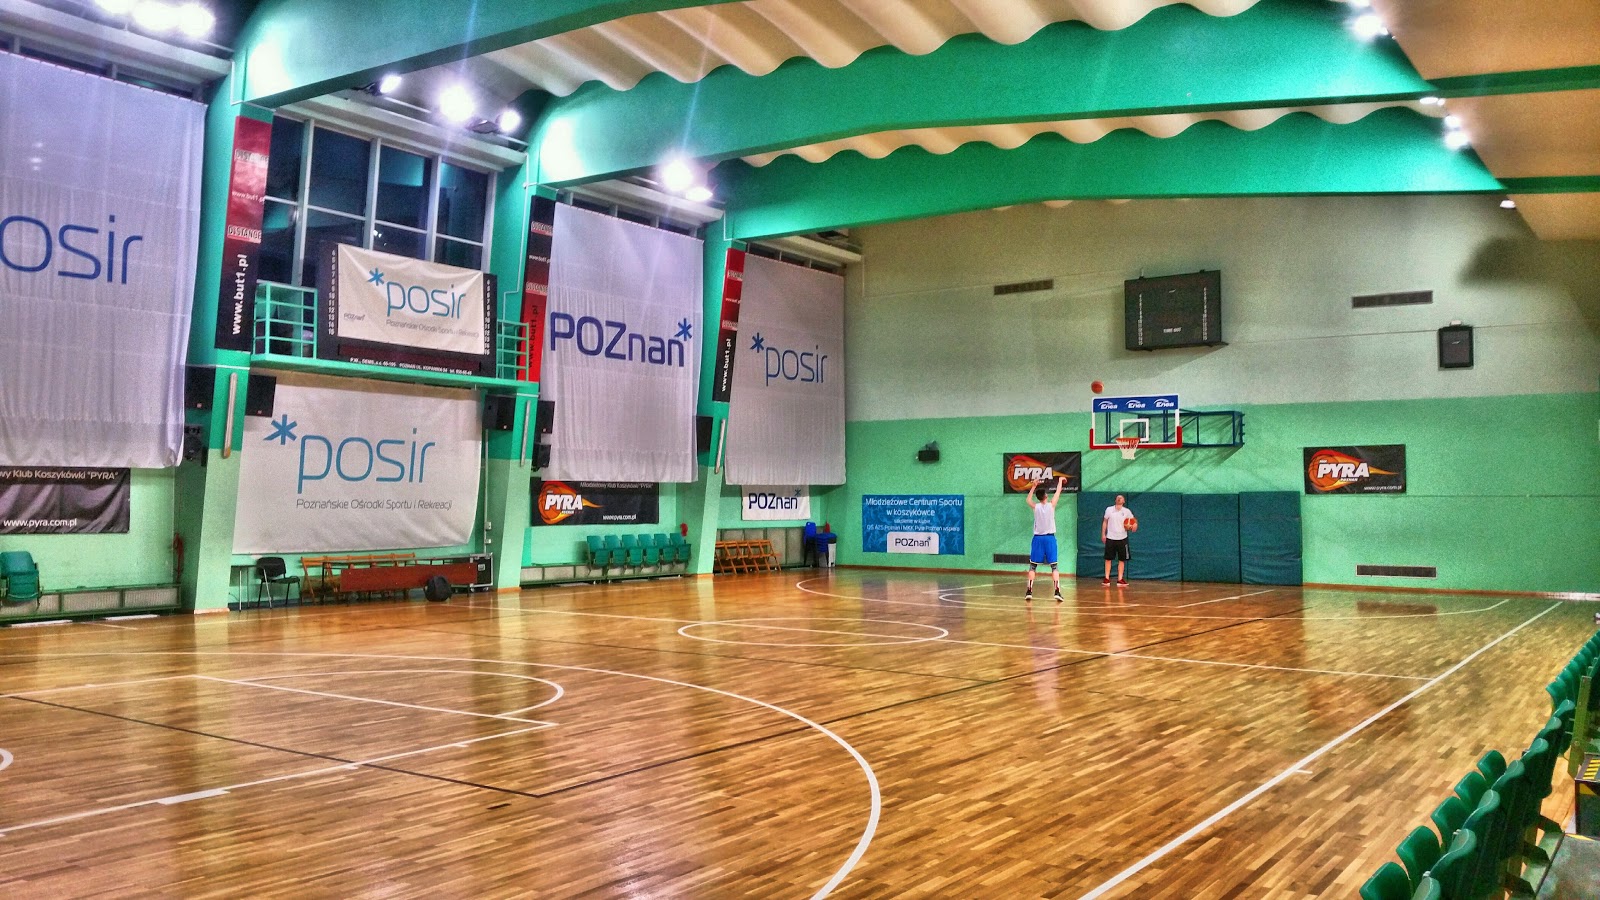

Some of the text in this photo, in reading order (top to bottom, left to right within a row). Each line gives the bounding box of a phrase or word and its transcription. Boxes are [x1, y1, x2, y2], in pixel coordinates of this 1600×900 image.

[228, 225, 262, 241] DISTANCE
[231, 253, 248, 335] www.but1.pl
[386, 281, 466, 319] posir
[721, 338, 732, 392] www.but1.pl
[766, 345, 828, 387] posir
[297, 428, 436, 495] posir
[12, 469, 33, 478] Klub
[34, 470, 86, 480] Koszykówki
[1014, 466, 1054, 480] PYRA
[1317, 462, 1370, 478] PYRA
[296, 498, 349, 510] Poznańskie
[350, 499, 384, 510] Ośrodki
[386, 500, 412, 511] Sportu
[544, 494, 583, 510] PYRA
[908, 498, 938, 506] Centrum
[938, 498, 963, 506] Sportu
[894, 508, 936, 517] koszykówce
[3, 518, 78, 527] www.pyra.com.pl
